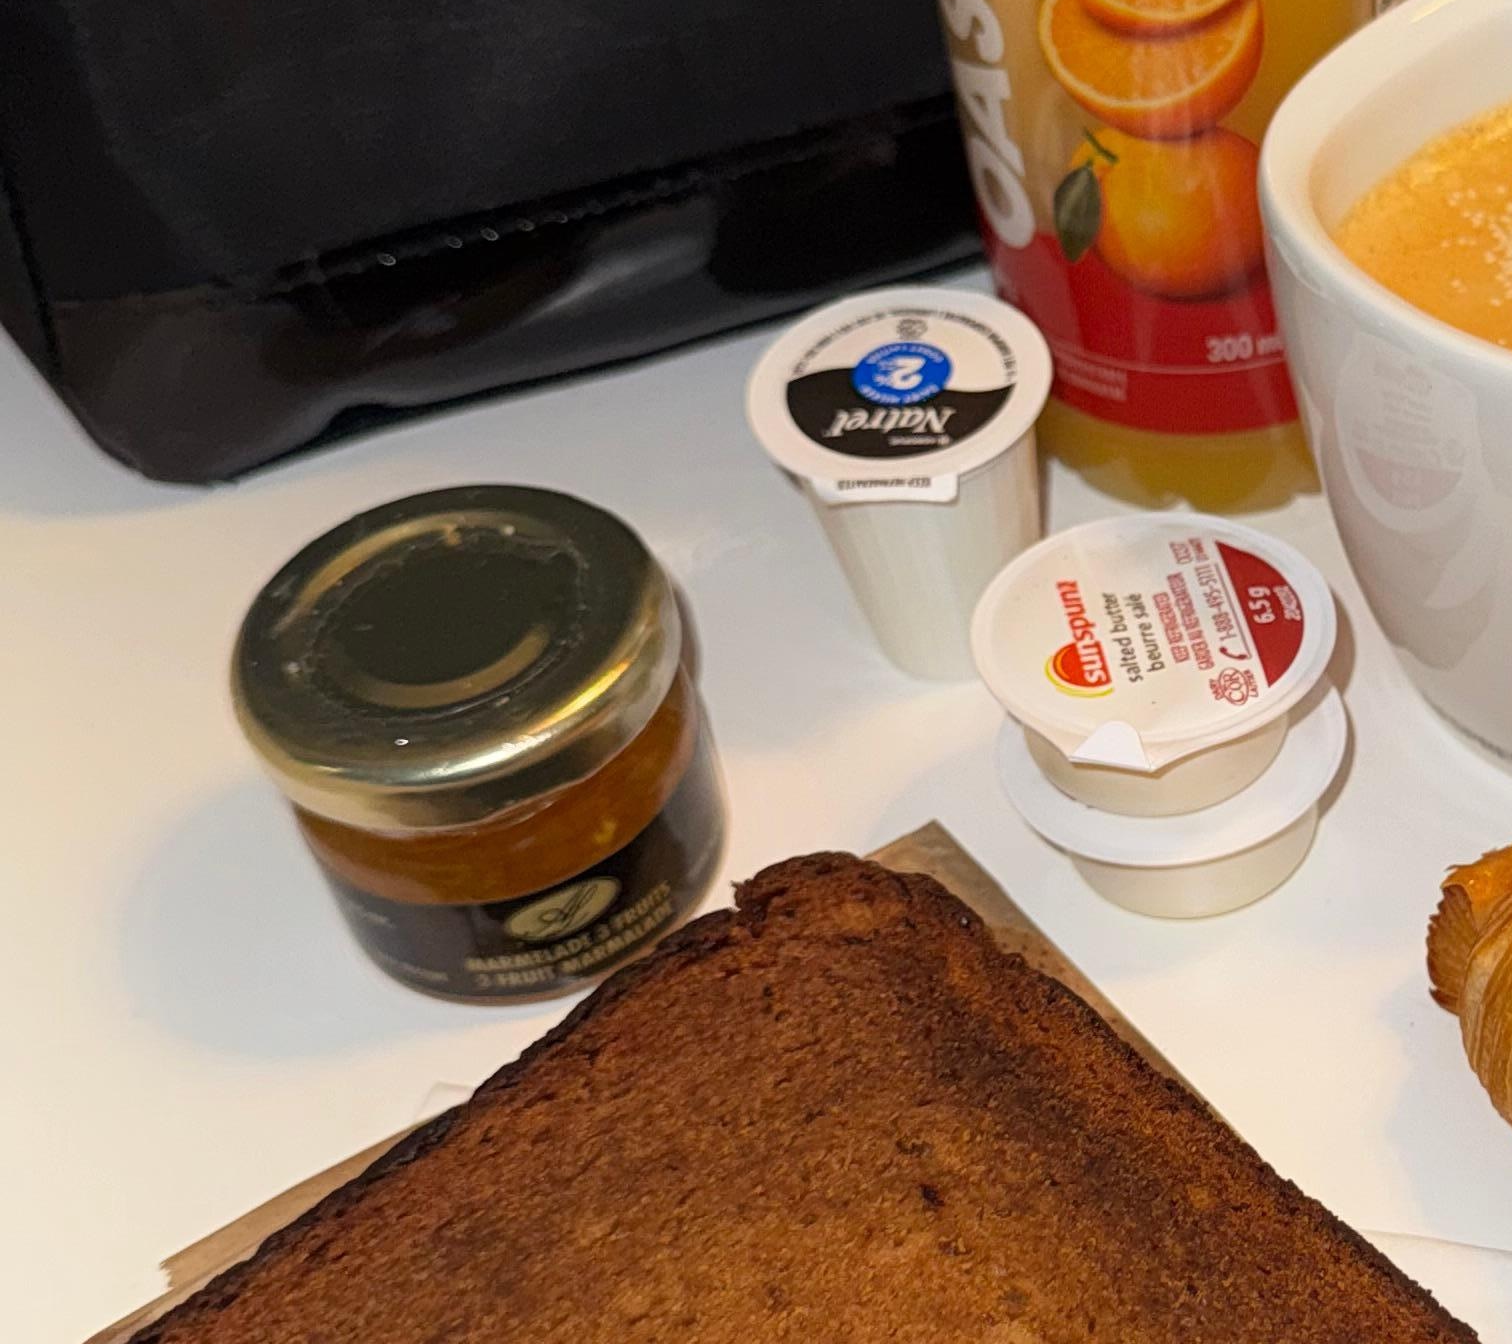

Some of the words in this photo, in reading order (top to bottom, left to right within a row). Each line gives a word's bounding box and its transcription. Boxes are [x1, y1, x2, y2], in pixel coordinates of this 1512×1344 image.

[1206, 332, 1253, 363] 300
[825, 407, 955, 437] Natrel
[1102, 592, 1128, 634] butter
[1125, 593, 1149, 619] salé
[1112, 637, 1144, 683] salted
[1138, 622, 1165, 672] beurre
